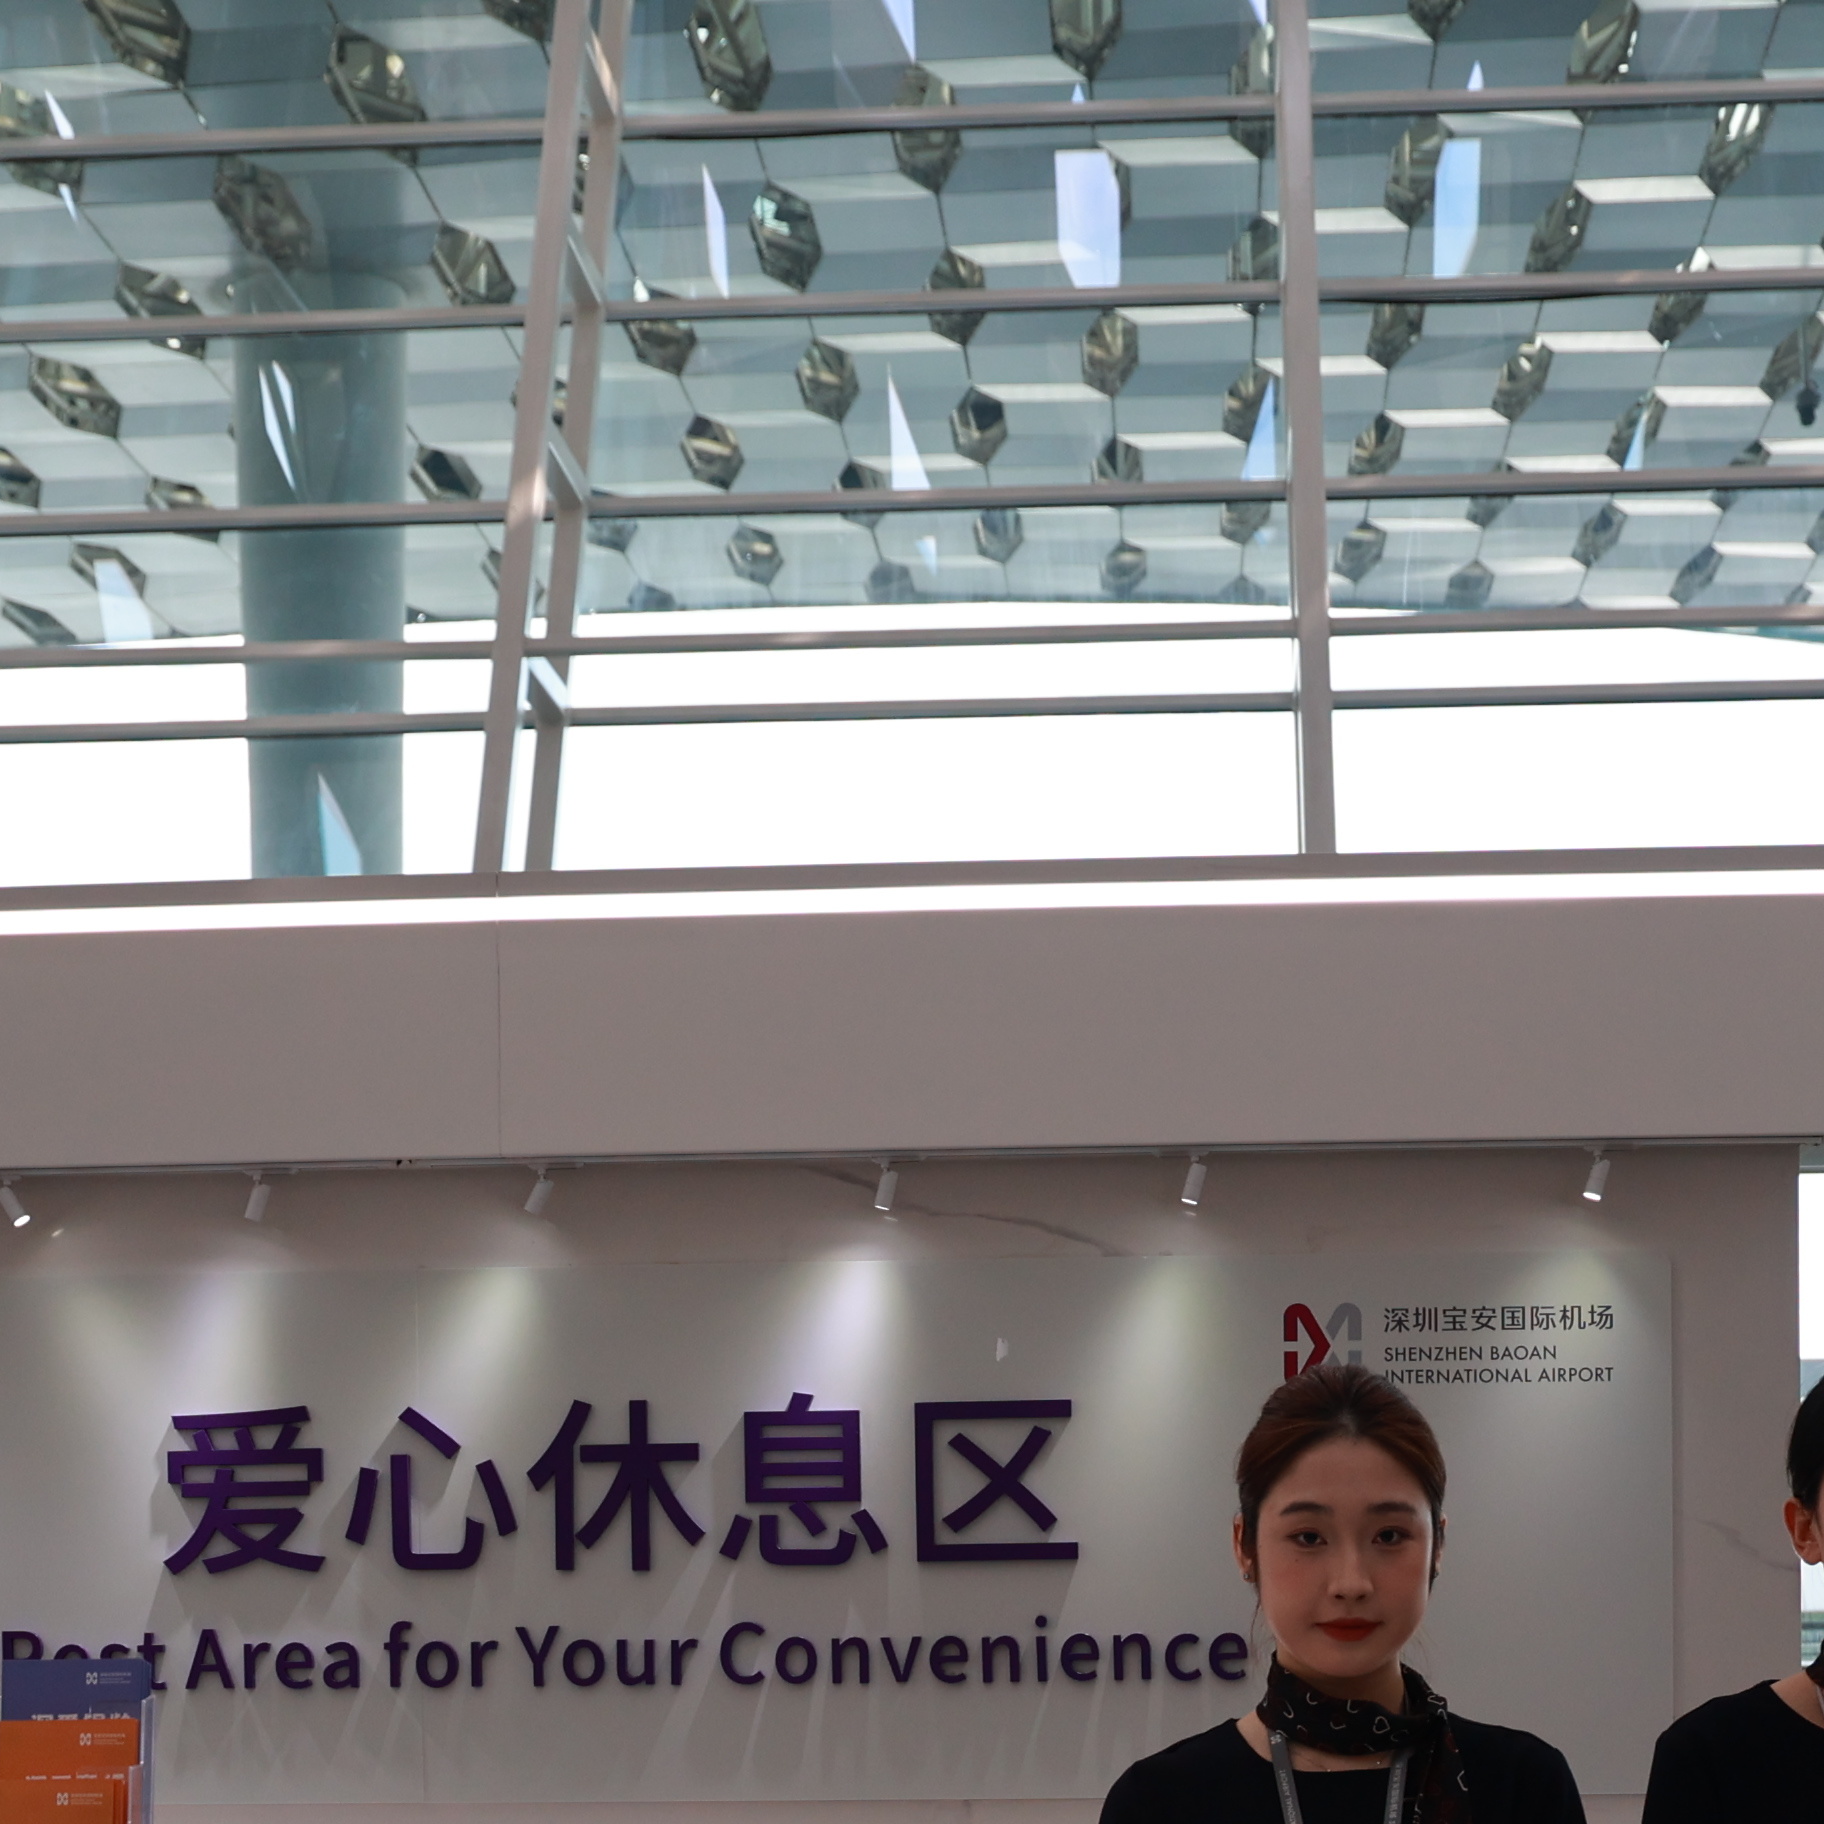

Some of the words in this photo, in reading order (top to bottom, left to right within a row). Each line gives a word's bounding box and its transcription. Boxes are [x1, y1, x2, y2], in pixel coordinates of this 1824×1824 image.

[1383, 1304, 1614, 1333] 深圳宝安国际机场
[1383, 1346, 1484, 1362] SHENZHEN
[1490, 1345, 1557, 1361] BAOAN
[1537, 1367, 1614, 1384] AIRPORT
[164, 1392, 1080, 1576] 爱心休息区
[185, 1627, 362, 1691] Area
[384, 1620, 499, 1689] for
[516, 1624, 700, 1689] Your
[717, 1614, 1250, 1686] Convenience
